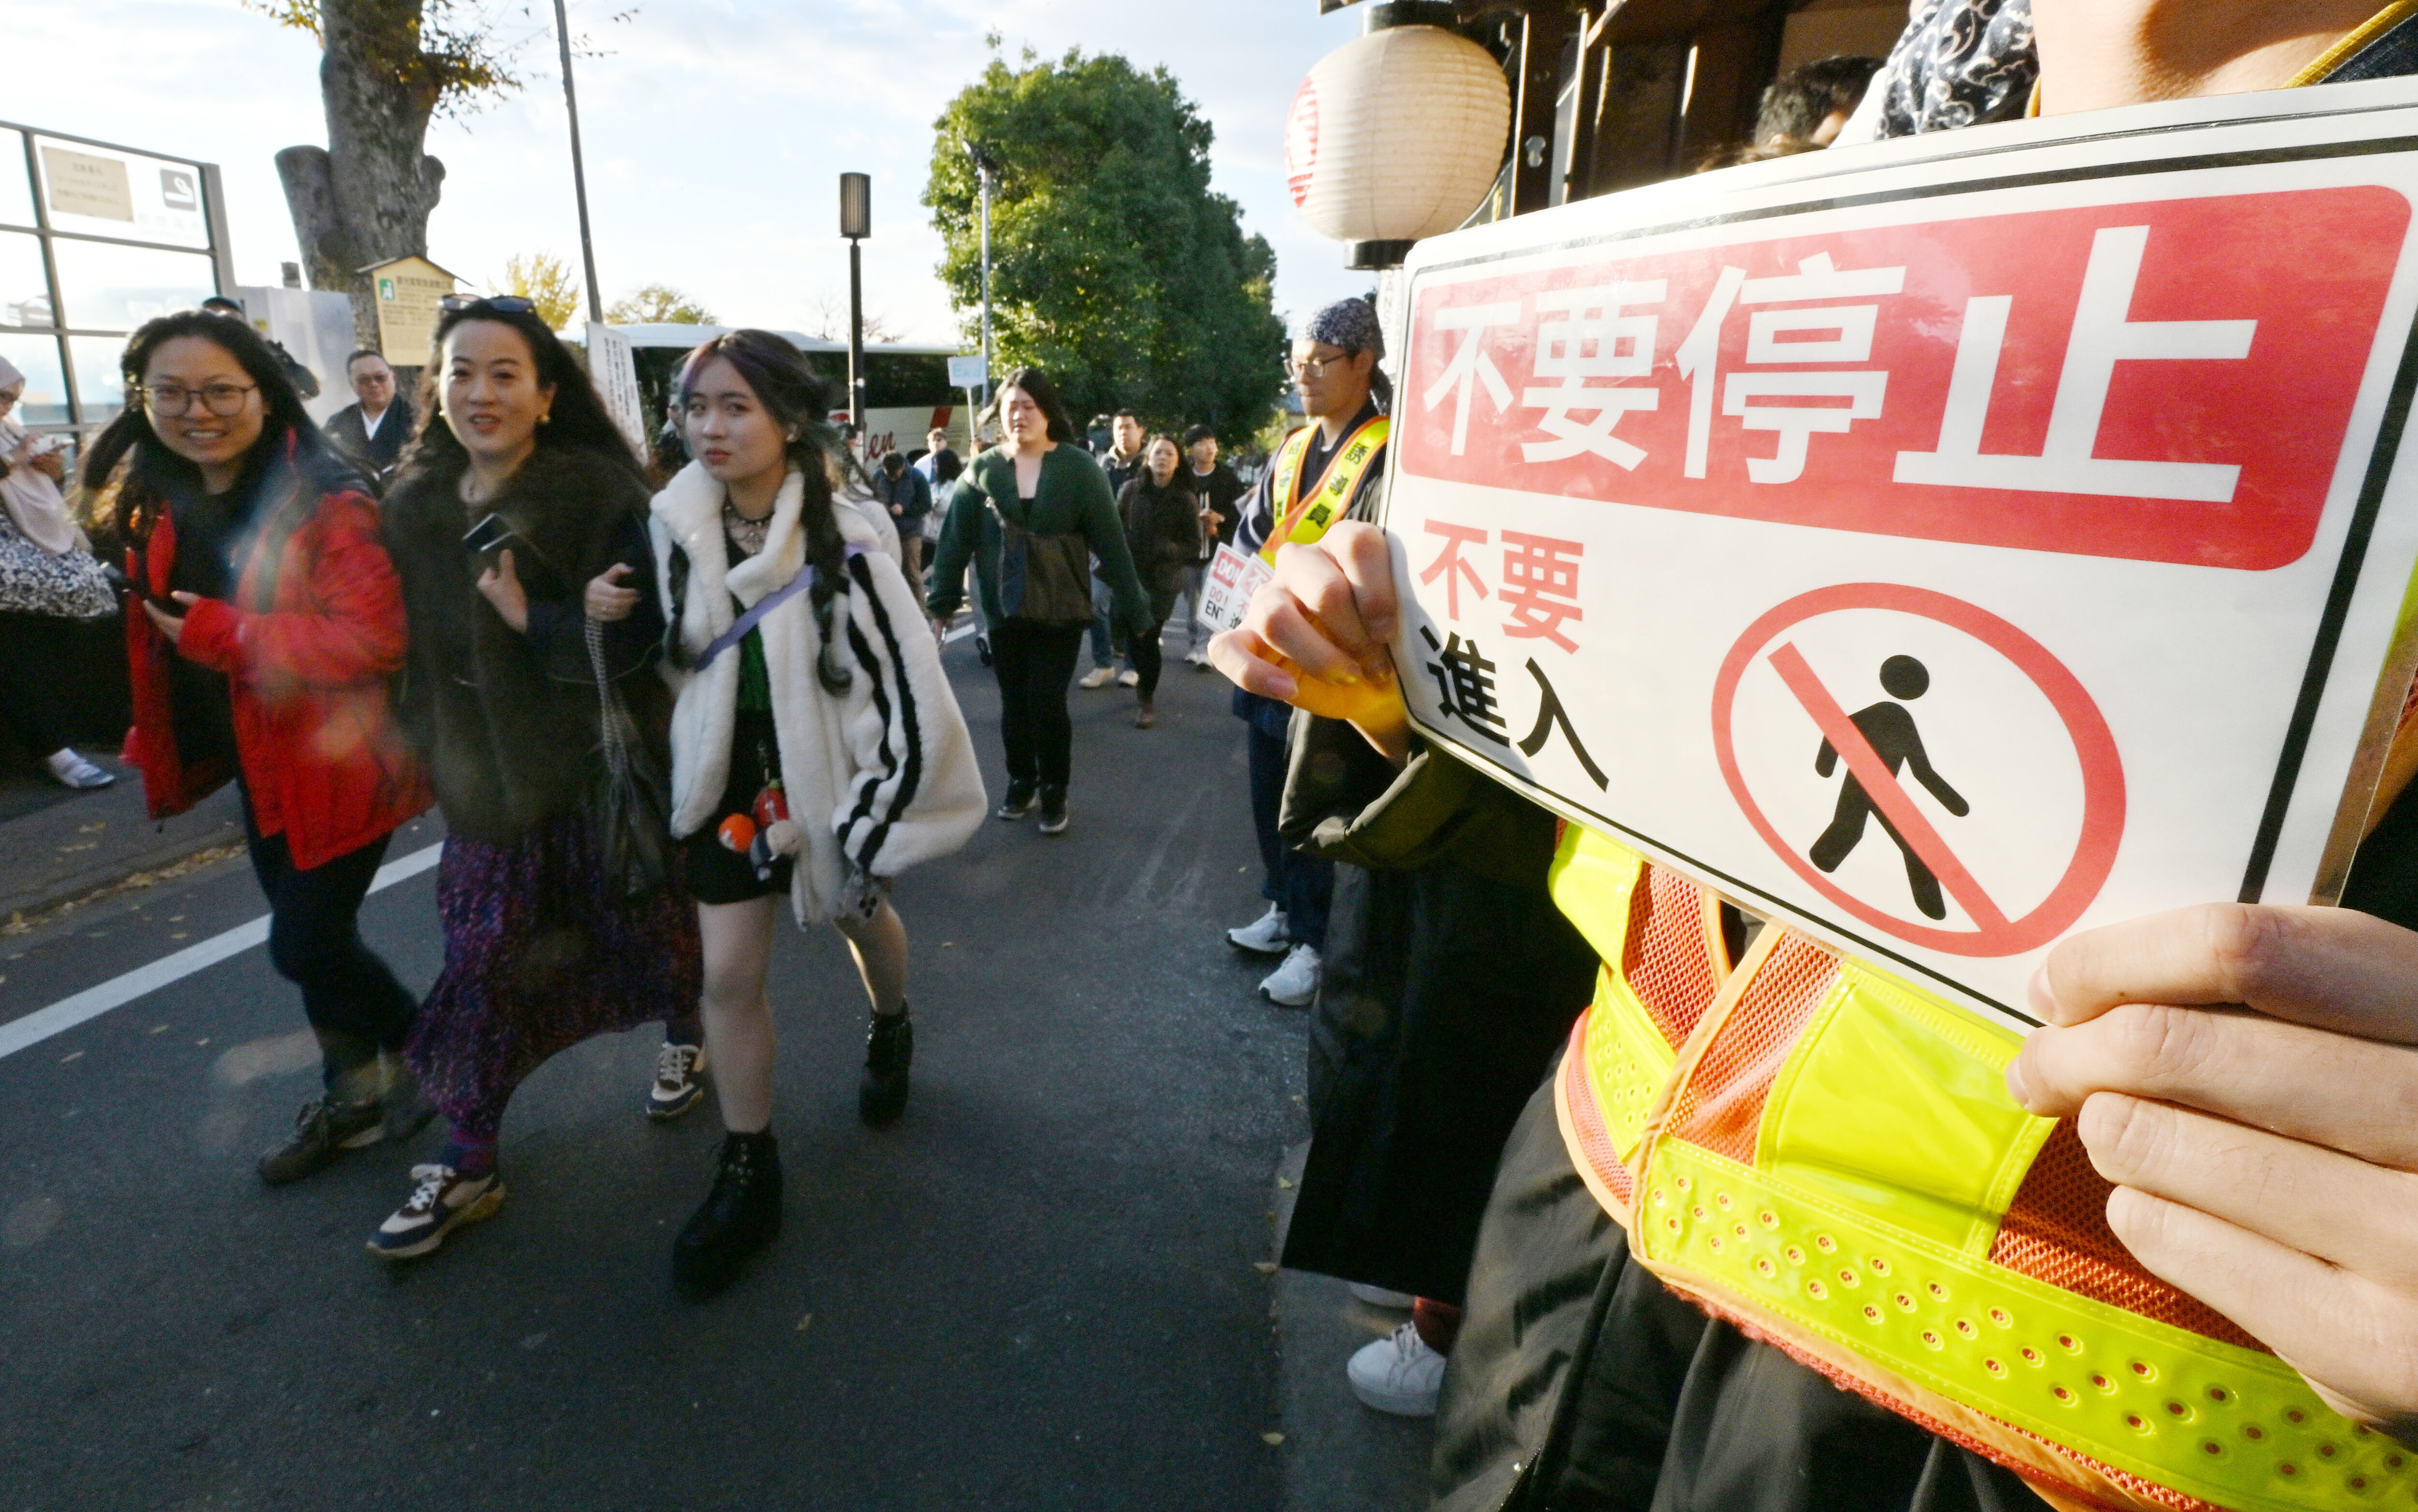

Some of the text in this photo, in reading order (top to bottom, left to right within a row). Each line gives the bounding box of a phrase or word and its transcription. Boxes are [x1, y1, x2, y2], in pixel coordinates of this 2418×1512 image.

[1423, 225, 2257, 503] 不要停止
[1419, 519, 1584, 655] 不要
[1420, 625, 1609, 793] 進入
